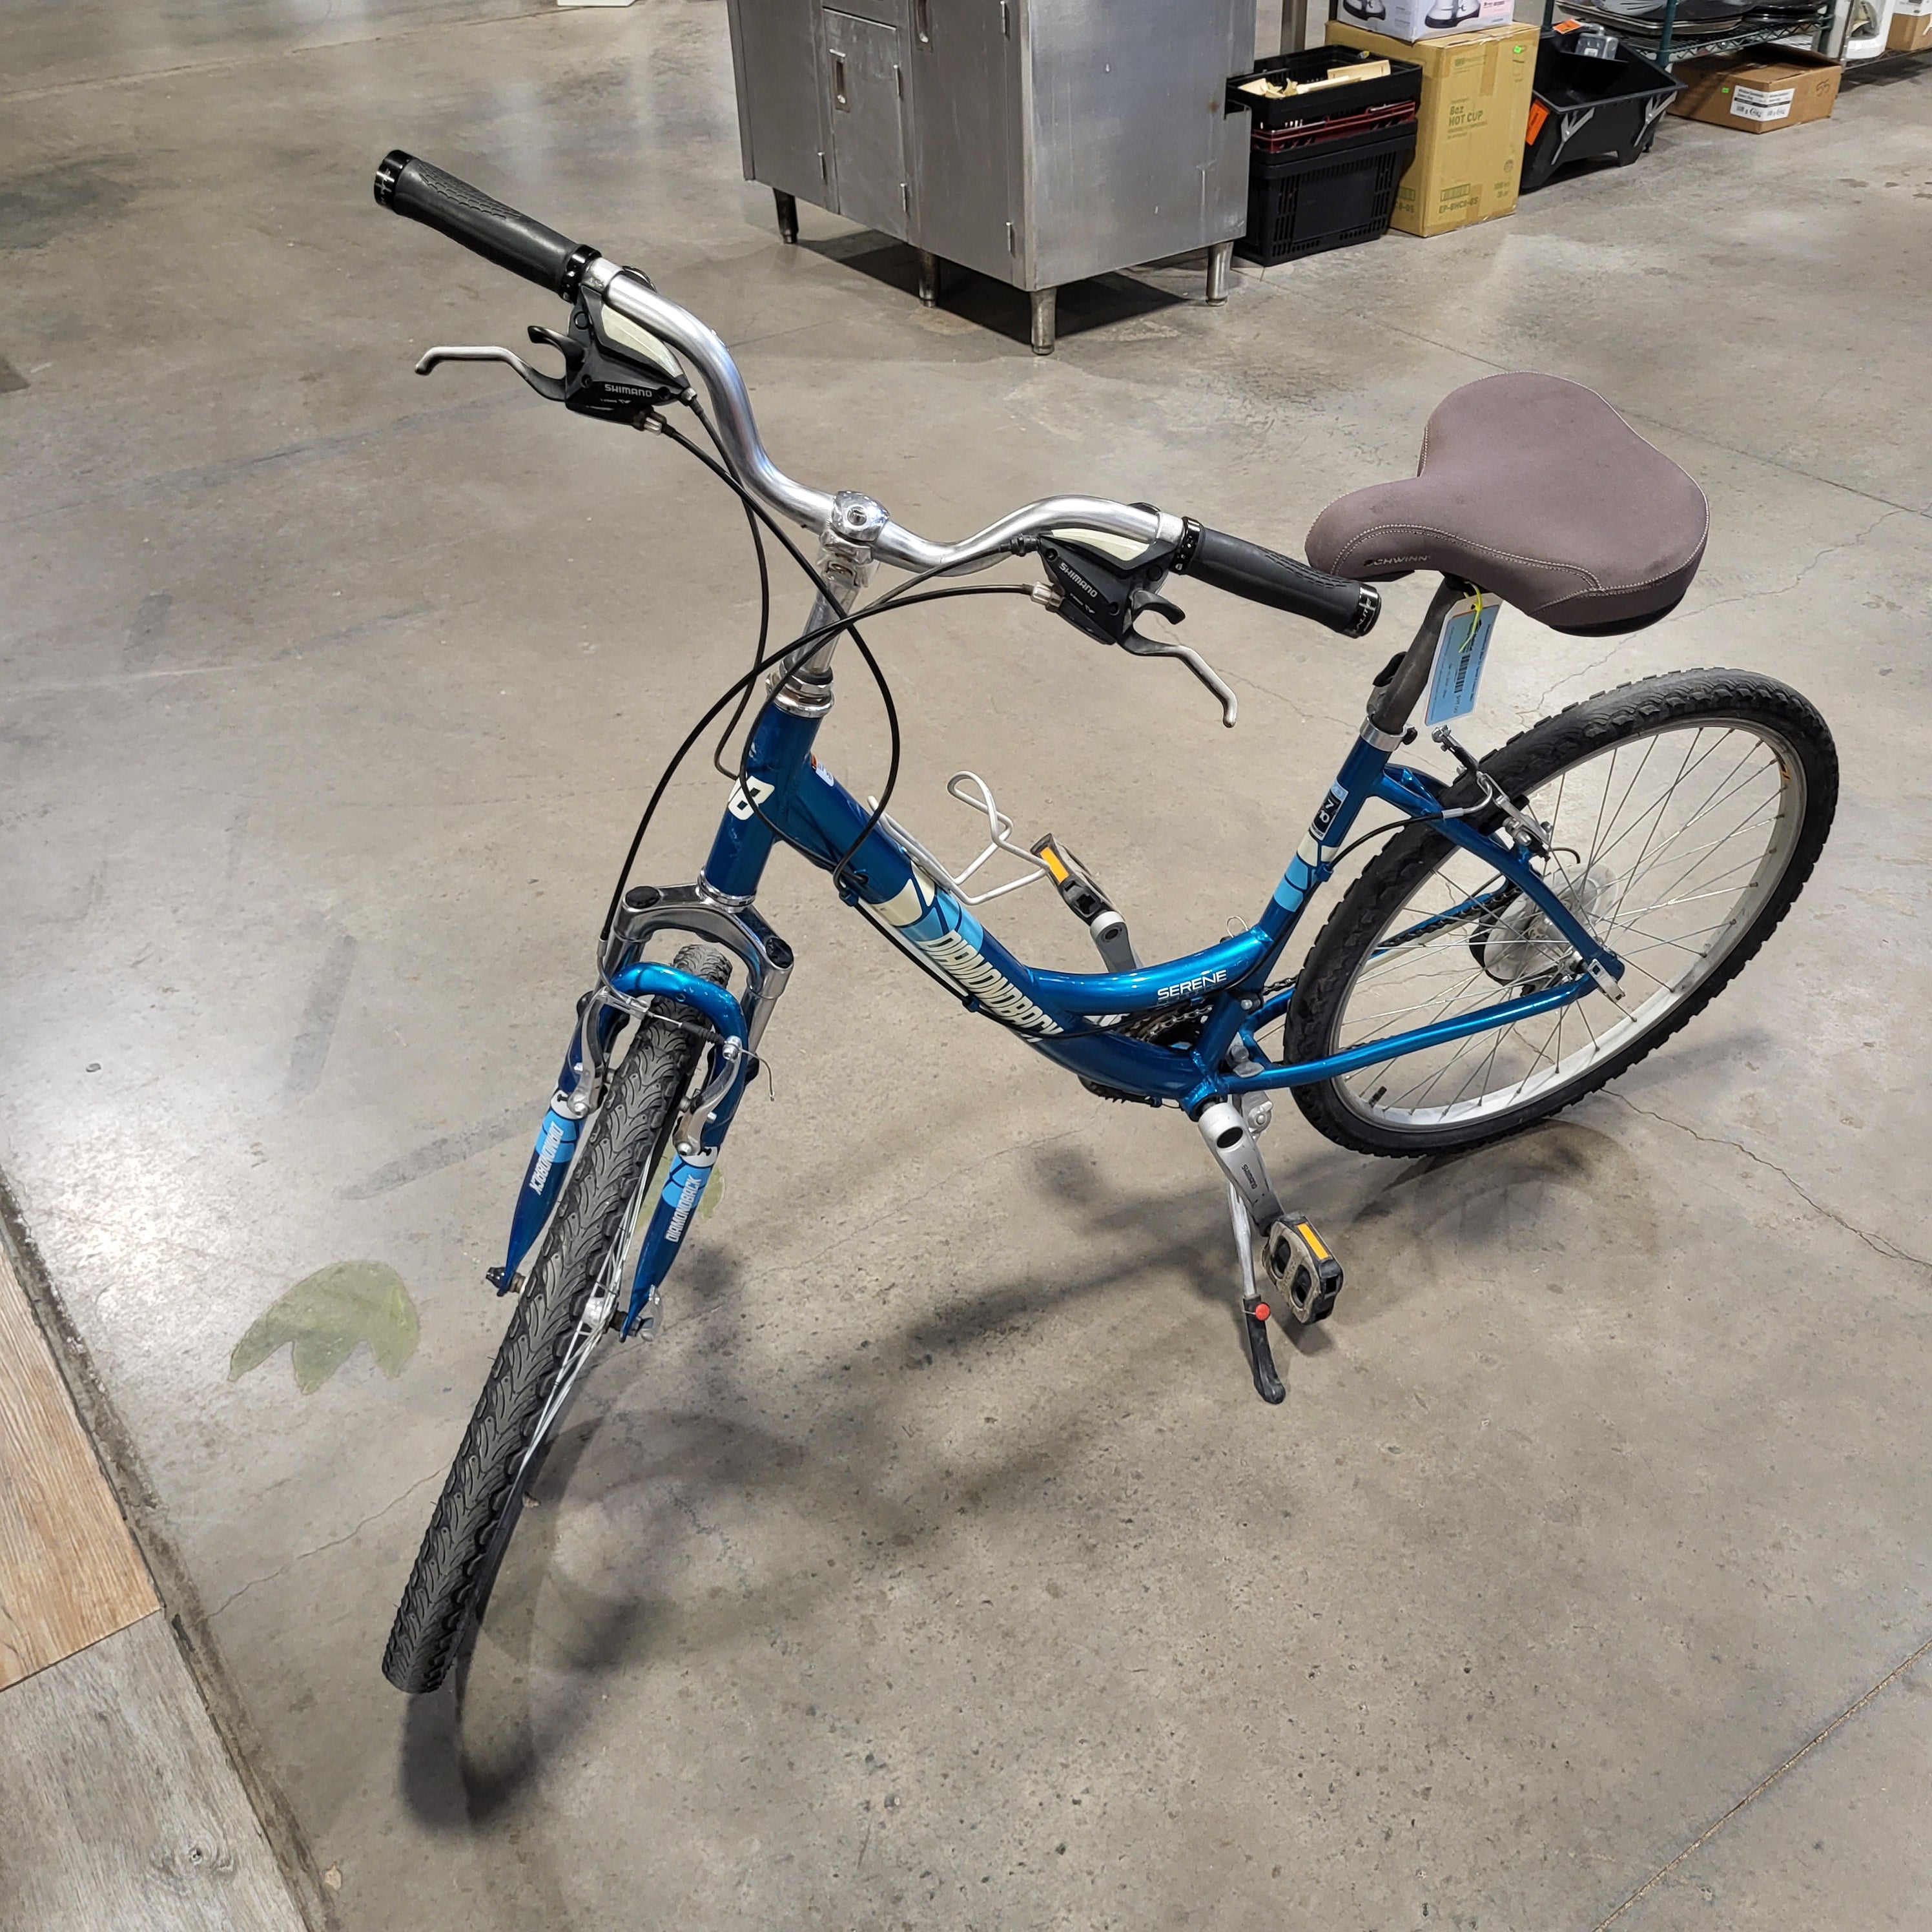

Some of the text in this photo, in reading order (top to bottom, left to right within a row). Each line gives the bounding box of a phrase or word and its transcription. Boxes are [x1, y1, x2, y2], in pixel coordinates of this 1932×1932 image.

[1448, 110, 1483, 127] HOT CUP
[604, 384, 652, 398] SHIMANO
[1058, 562, 1098, 598] SHIMANO
[917, 929, 1064, 1043] DIAMONDBACK
[1156, 969, 1227, 1000] SERENE
[529, 1121, 564, 1195] DIAMONDBACK
[1241, 1164, 1258, 1189] SHIMANO
[664, 1174, 702, 1243] DIAMONDBACK
